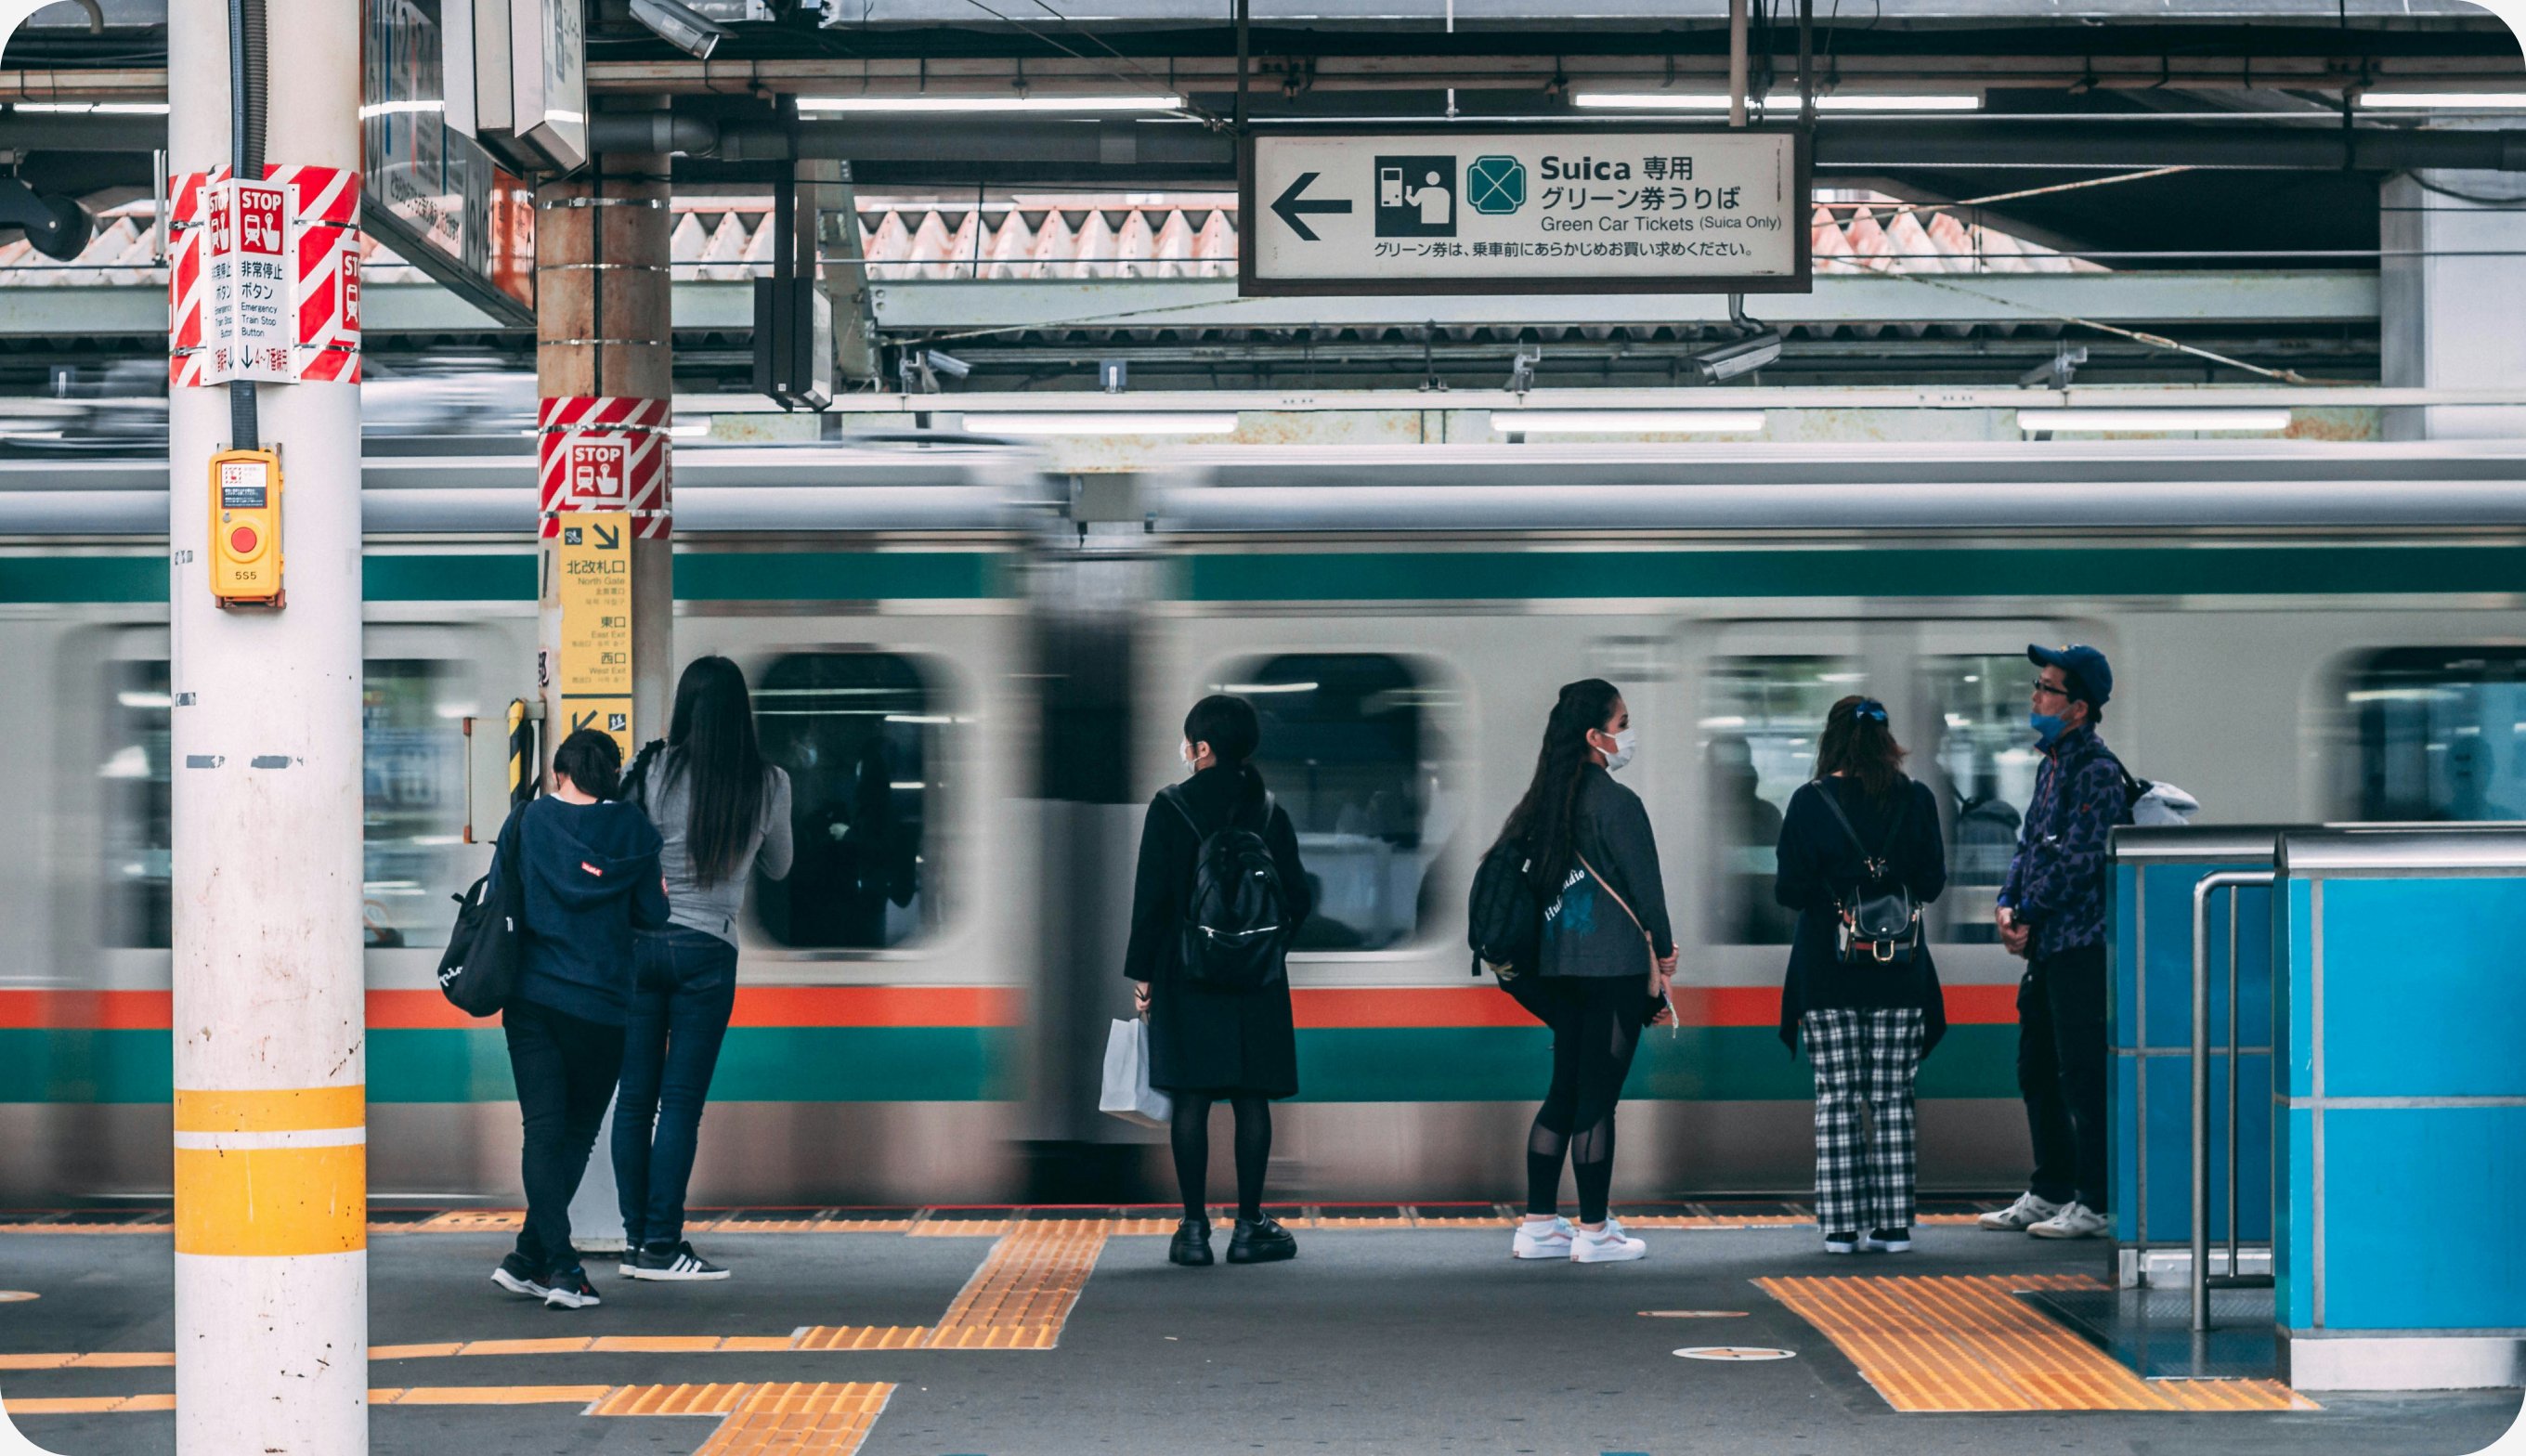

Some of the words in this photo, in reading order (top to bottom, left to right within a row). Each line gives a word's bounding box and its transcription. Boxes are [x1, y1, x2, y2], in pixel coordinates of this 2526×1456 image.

[1541, 156, 1632, 181] Suica
[1643, 156, 1693, 181] 専用
[209, 191, 229, 214] STOP
[241, 191, 282, 212] STOP
[1542, 186, 1741, 211] グリーン券うりば
[1541, 216, 1593, 231] Green
[1598, 216, 1629, 231] Car
[1634, 215, 1694, 231] Tickets
[1699, 215, 1743, 229] (Suica
[1746, 215, 1782, 230] Only)
[1374, 241, 1752, 258] グリーン券は、乗車前にあらかじめお買い求めください。
[241, 261, 283, 281] 非常停止
[241, 282, 273, 301] ボタン
[241, 302, 278, 315] Emergency
[241, 314, 259, 325] Train
[261, 316, 277, 327] Stop
[241, 326, 265, 338] Button
[575, 448, 620, 462] STOP
[566, 560, 626, 574] 北改札口
[578, 577, 602, 585] North
[604, 577, 625, 585] Gate
[601, 616, 626, 628] 東口
[591, 630, 608, 639] East
[601, 652, 626, 664] 西口
[589, 667, 609, 675] West
